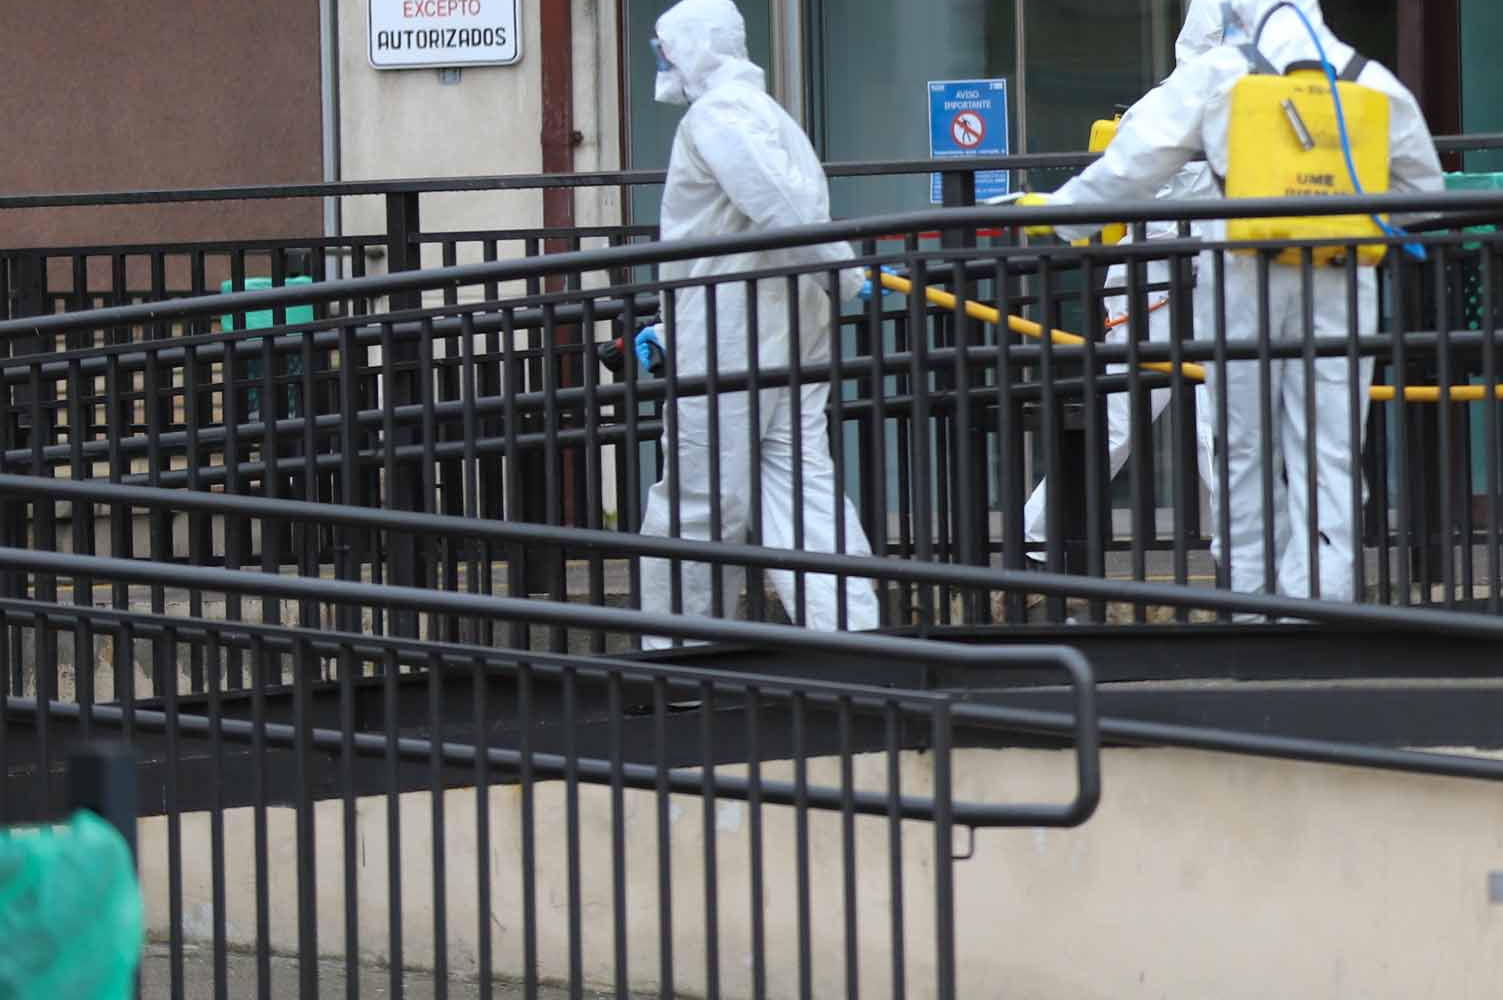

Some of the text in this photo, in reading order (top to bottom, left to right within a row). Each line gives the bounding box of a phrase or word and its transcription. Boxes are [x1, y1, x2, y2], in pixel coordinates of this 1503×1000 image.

[377, 27, 507, 50] AUTORIZADOS
[956, 89, 979, 100] AVISO
[944, 99, 991, 111] IMPORTANTE
[1296, 173, 1334, 187] UME
